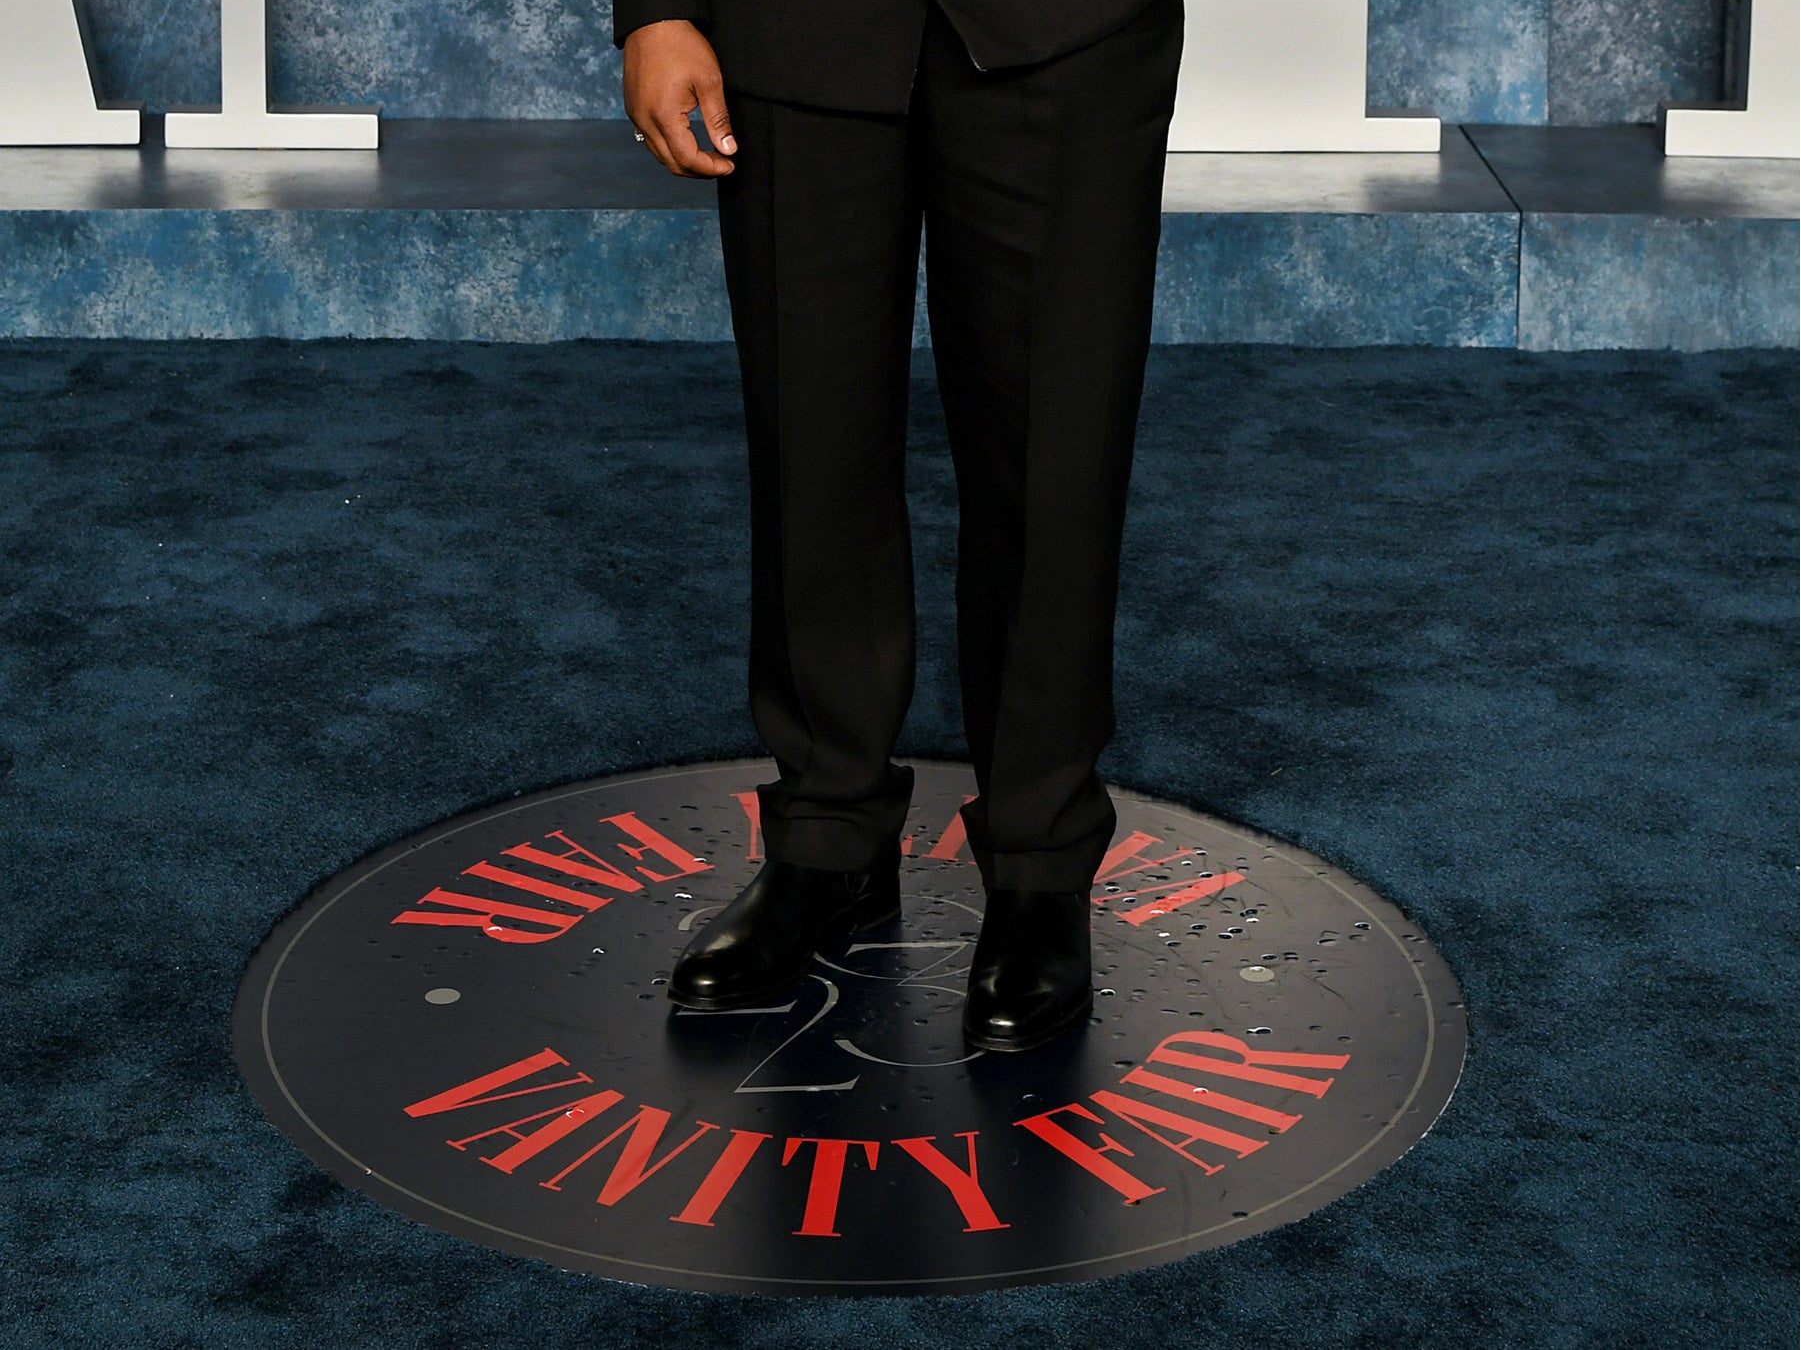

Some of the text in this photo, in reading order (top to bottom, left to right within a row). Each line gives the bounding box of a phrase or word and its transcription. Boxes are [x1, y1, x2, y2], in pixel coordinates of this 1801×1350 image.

[391, 811, 716, 944] FAIR
[403, 1030, 1351, 1237] VANITY FAIR
